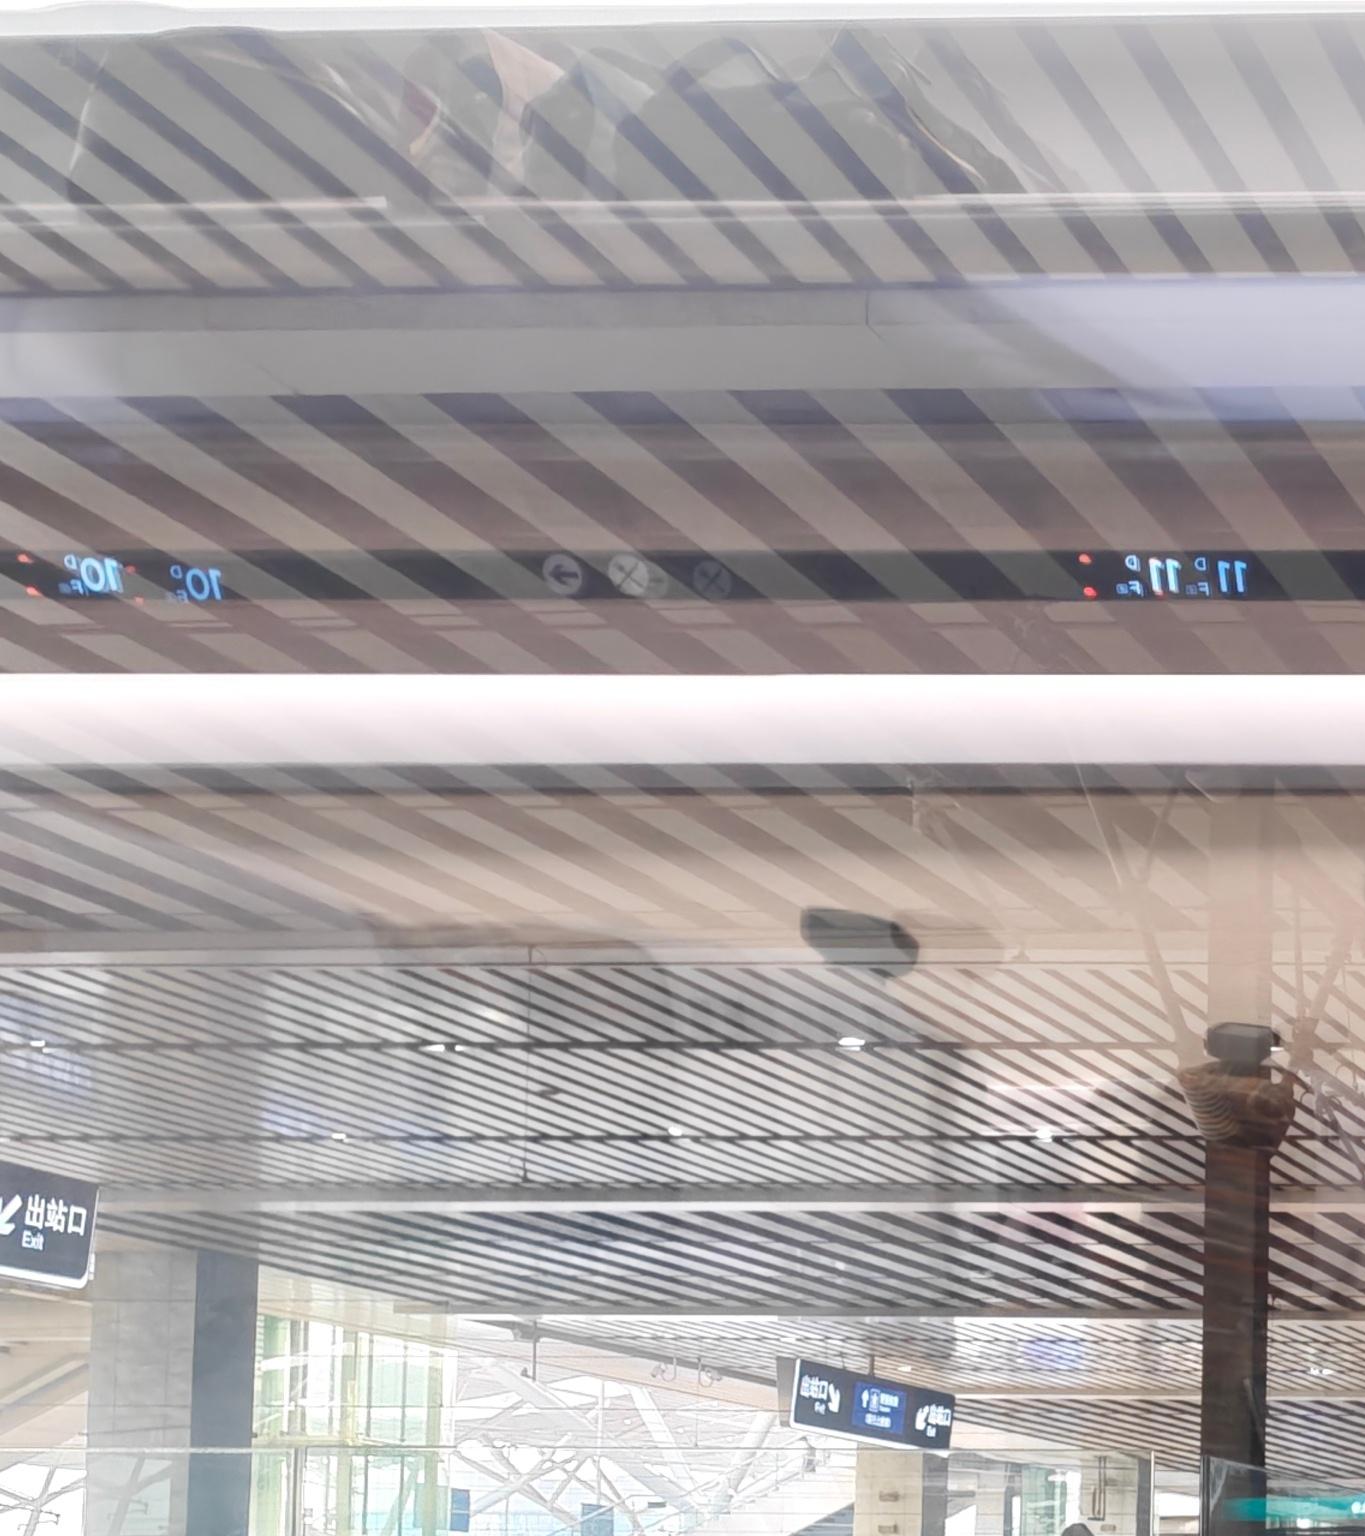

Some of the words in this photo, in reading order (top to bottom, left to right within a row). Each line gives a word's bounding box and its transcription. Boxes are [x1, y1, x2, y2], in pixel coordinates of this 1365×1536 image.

[24, 1194, 87, 1236] 出站口
[22, 1230, 44, 1250] Exit
